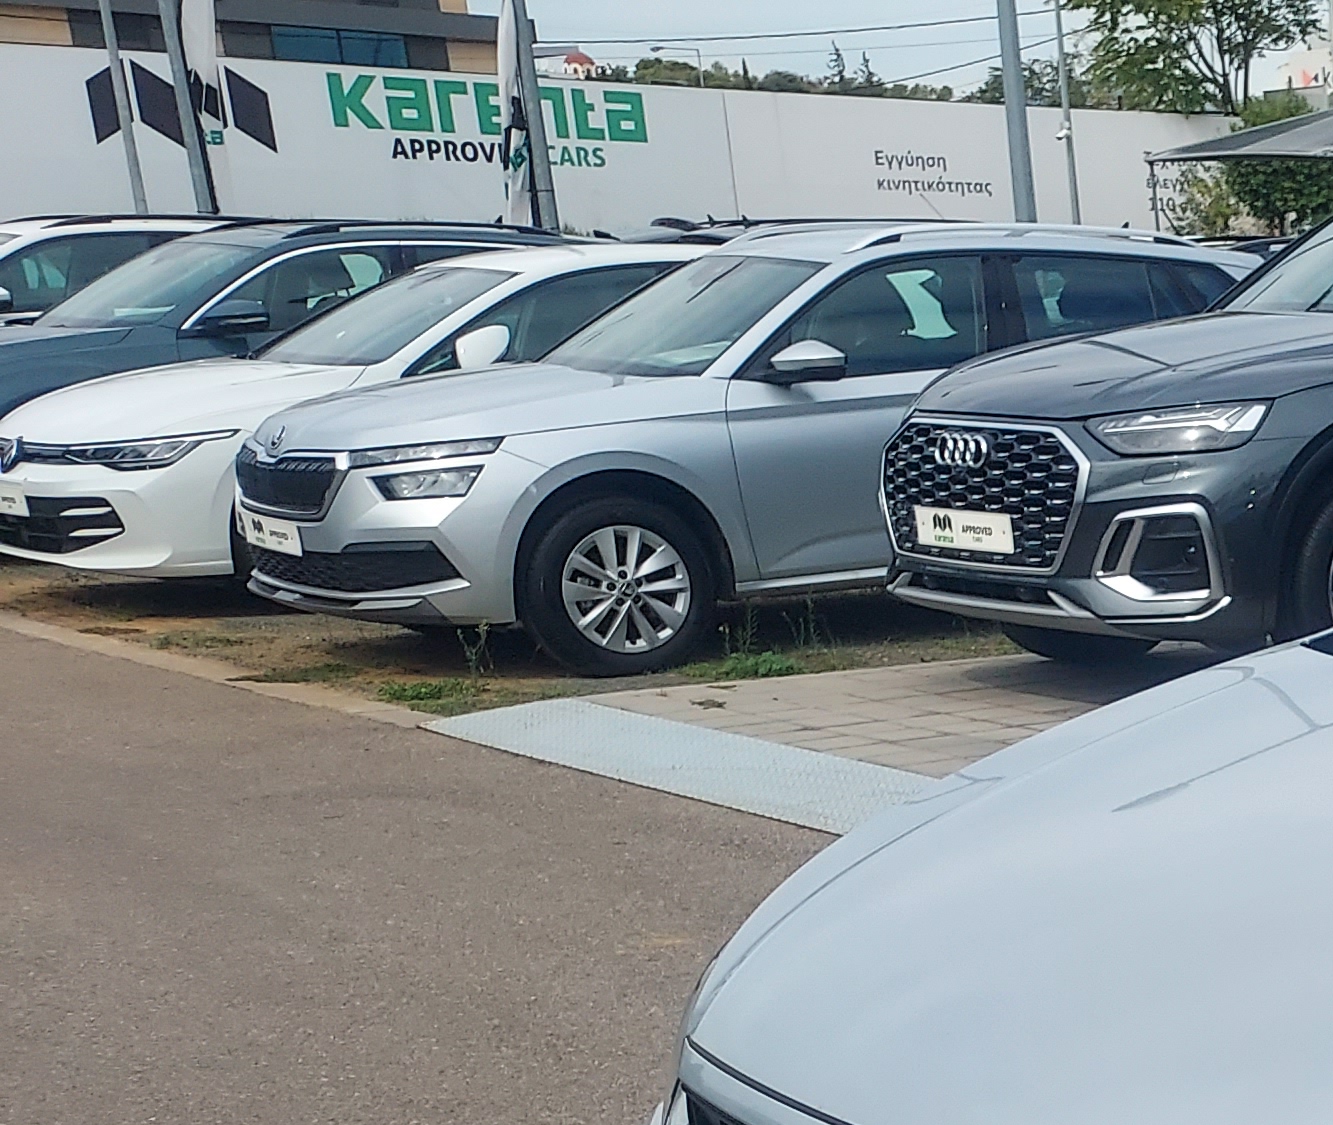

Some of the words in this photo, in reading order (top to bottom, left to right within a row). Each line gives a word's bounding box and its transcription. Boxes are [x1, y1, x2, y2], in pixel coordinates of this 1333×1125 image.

[391, 138, 505, 164] APPROV
[874, 150, 947, 172] Εγγύηση
[877, 176, 993, 197] κινητικότητας
